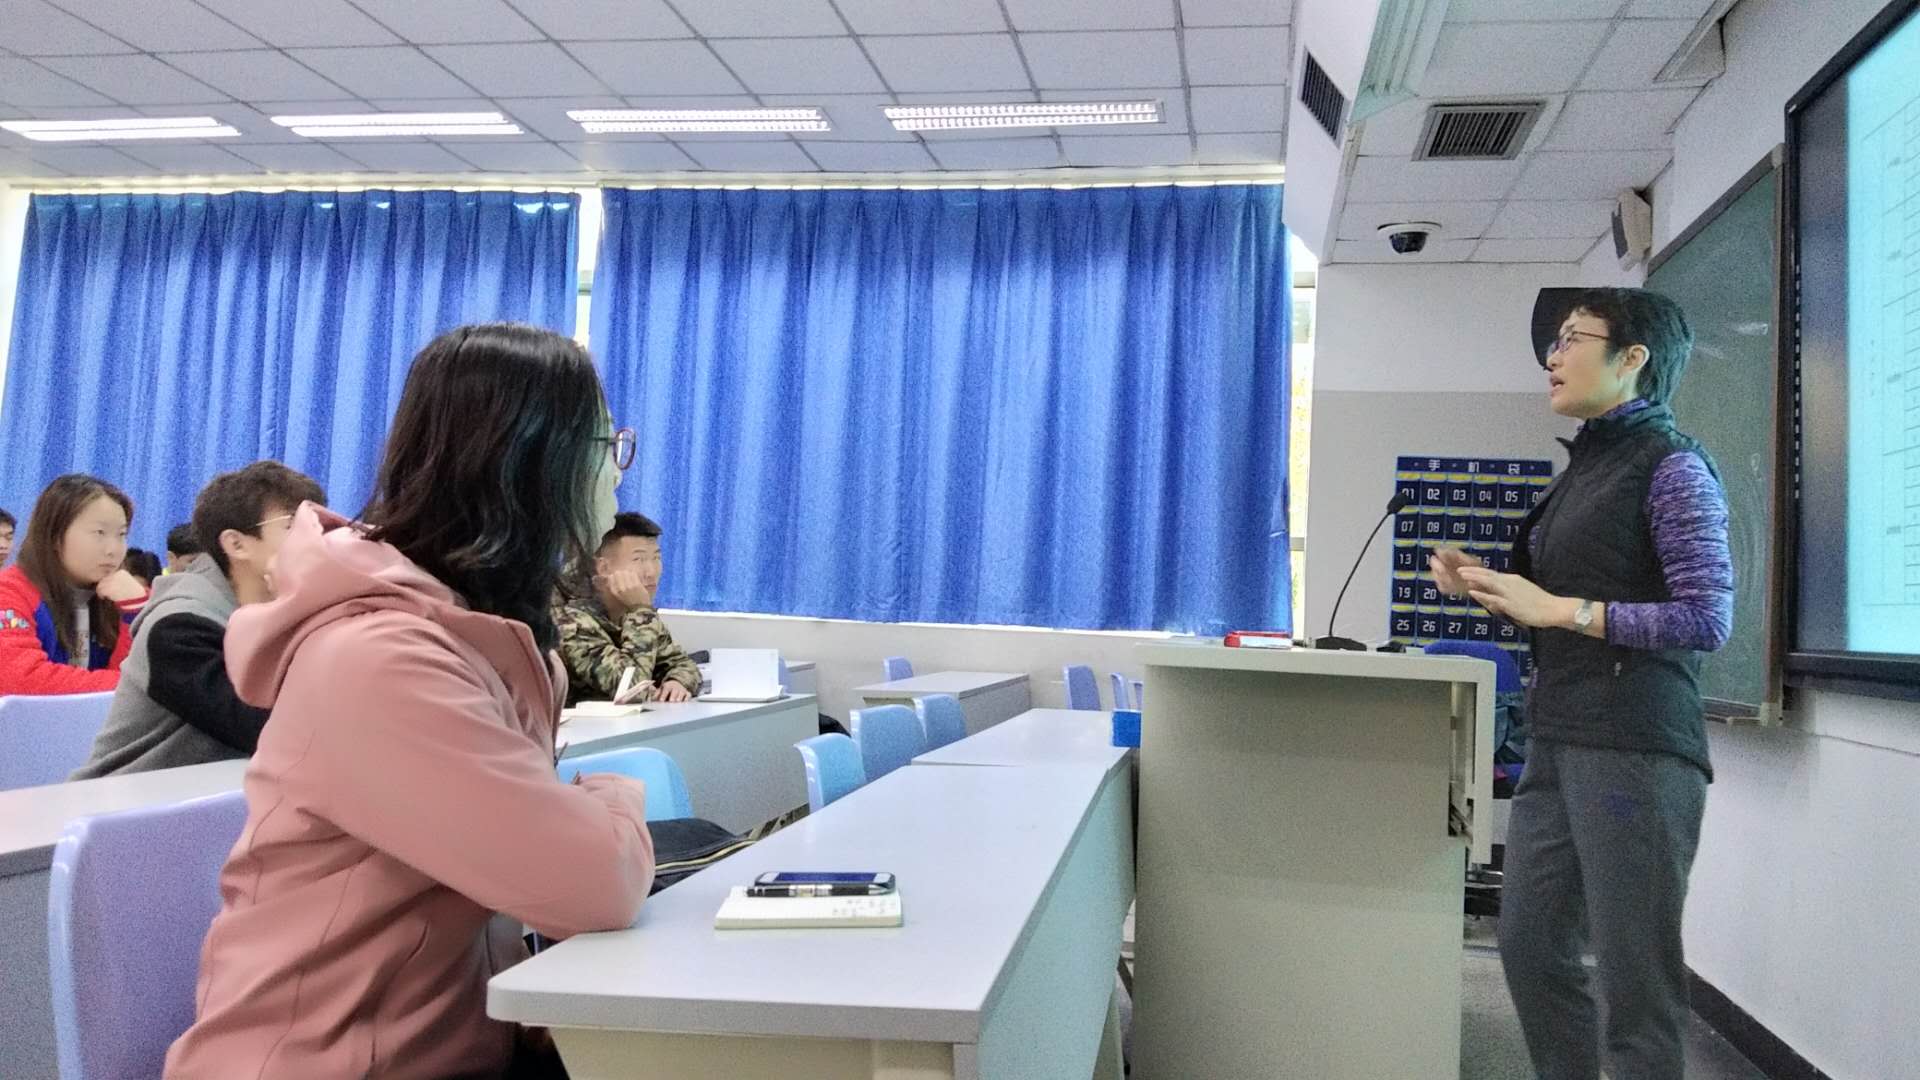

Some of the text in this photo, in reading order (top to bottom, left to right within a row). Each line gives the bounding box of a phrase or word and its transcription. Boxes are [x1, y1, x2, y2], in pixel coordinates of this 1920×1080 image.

[1427, 488, 1440, 501] 02
[1453, 489, 1466, 502] 03
[1479, 490, 1492, 502] 04
[1505, 491, 1518, 503] 05
[1401, 520, 1414, 533] 07
[1427, 521, 1440, 533] 08
[1453, 522, 1466, 534] 09
[1480, 523, 1493, 535] 10
[1399, 553, 1412, 565] 13
[1398, 586, 1411, 599] 19
[1423, 588, 1437, 600] 20
[1396, 619, 1514, 637] 25 26 27 28 29
